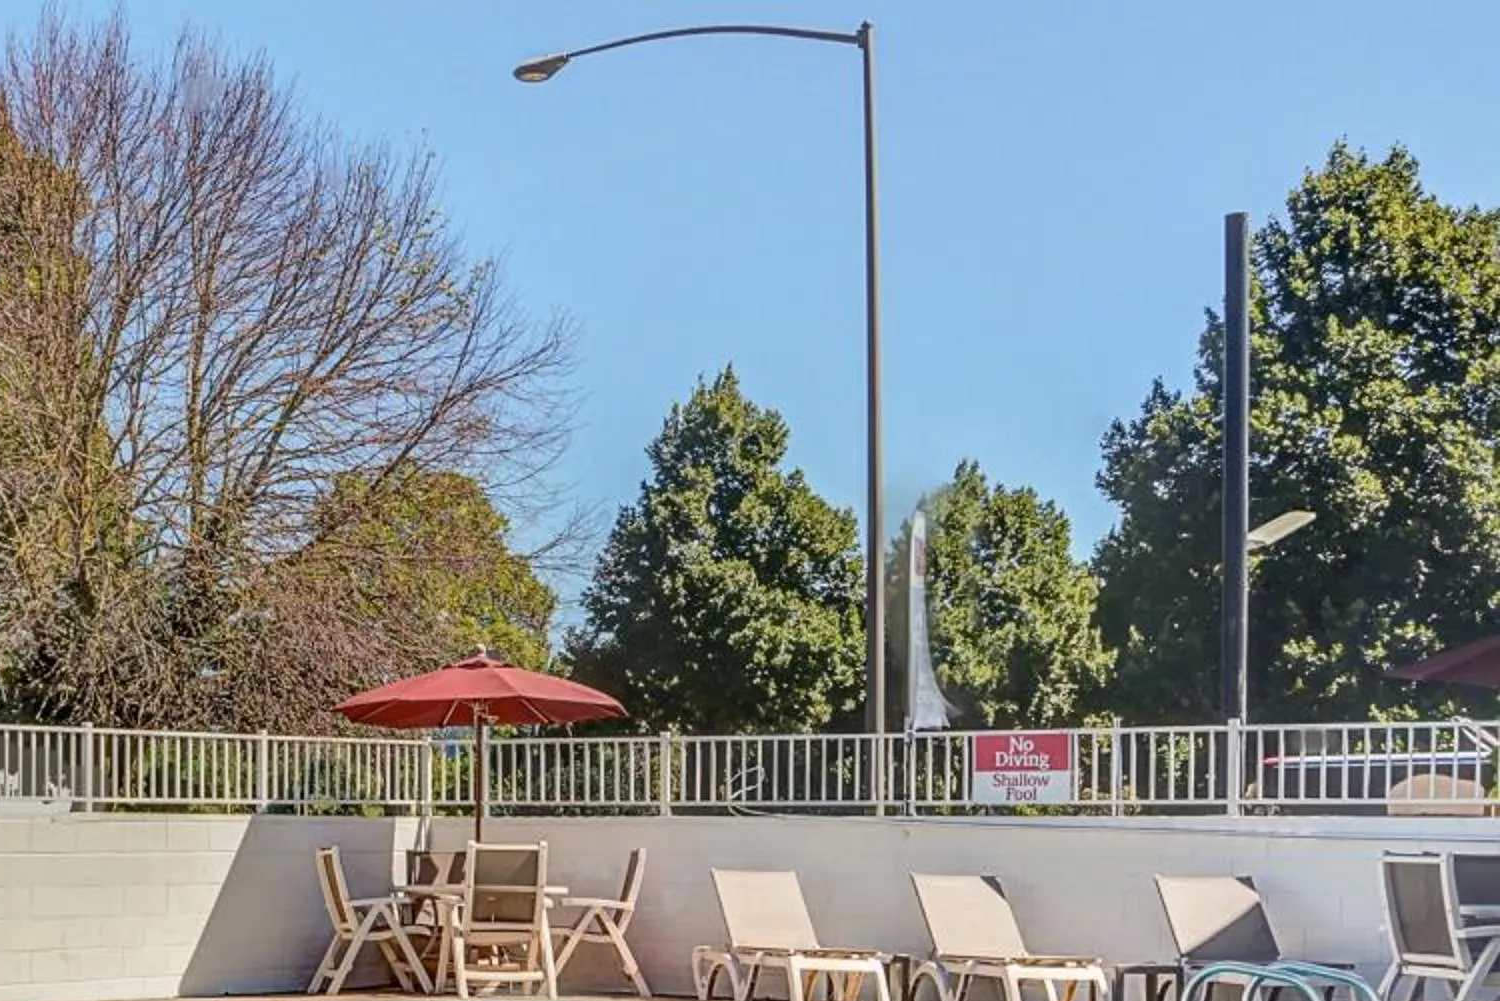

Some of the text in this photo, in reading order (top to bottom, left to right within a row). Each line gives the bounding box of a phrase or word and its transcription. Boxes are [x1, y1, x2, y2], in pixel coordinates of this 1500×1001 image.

[1009, 735, 1035, 753] No
[995, 751, 1051, 769] Diving
[992, 773, 1051, 787] Shallow
[1005, 787, 1037, 801] Pool
